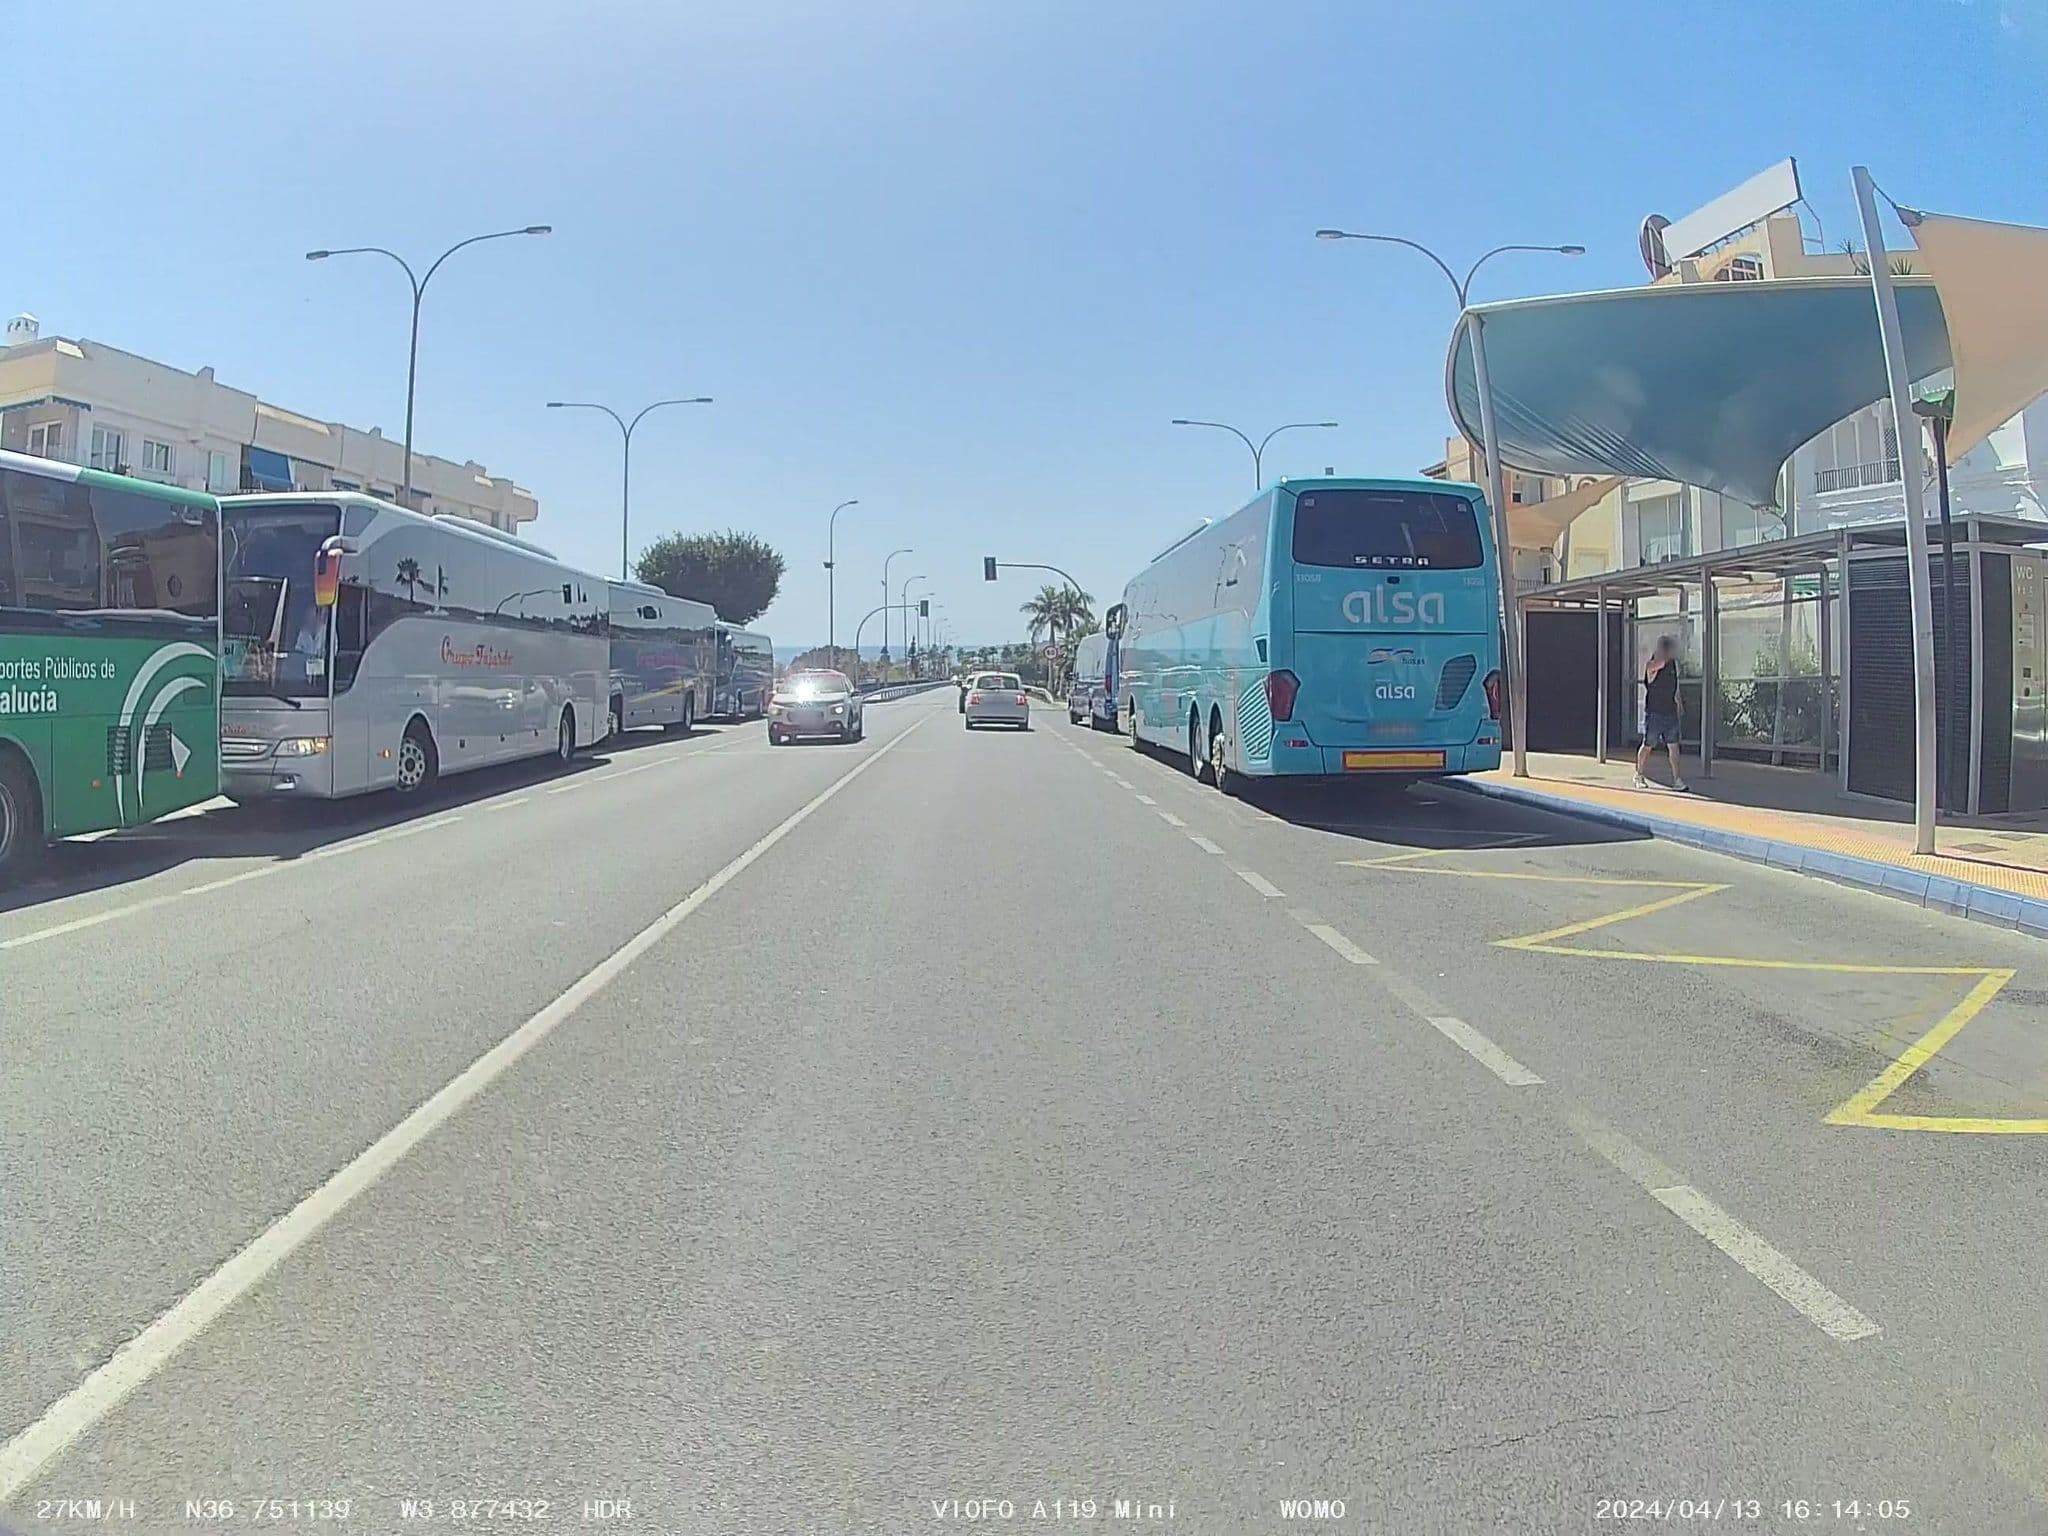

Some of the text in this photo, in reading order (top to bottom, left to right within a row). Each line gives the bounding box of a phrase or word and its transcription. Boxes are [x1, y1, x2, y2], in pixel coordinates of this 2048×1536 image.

[1354, 555, 1430, 566] SETRA
[2016, 566, 2033, 580] WC
[1342, 583, 1445, 625] alsa
[45, 656, 97, 680] Públicos
[100, 657, 116, 679] de
[1375, 682, 1416, 700] alsa
